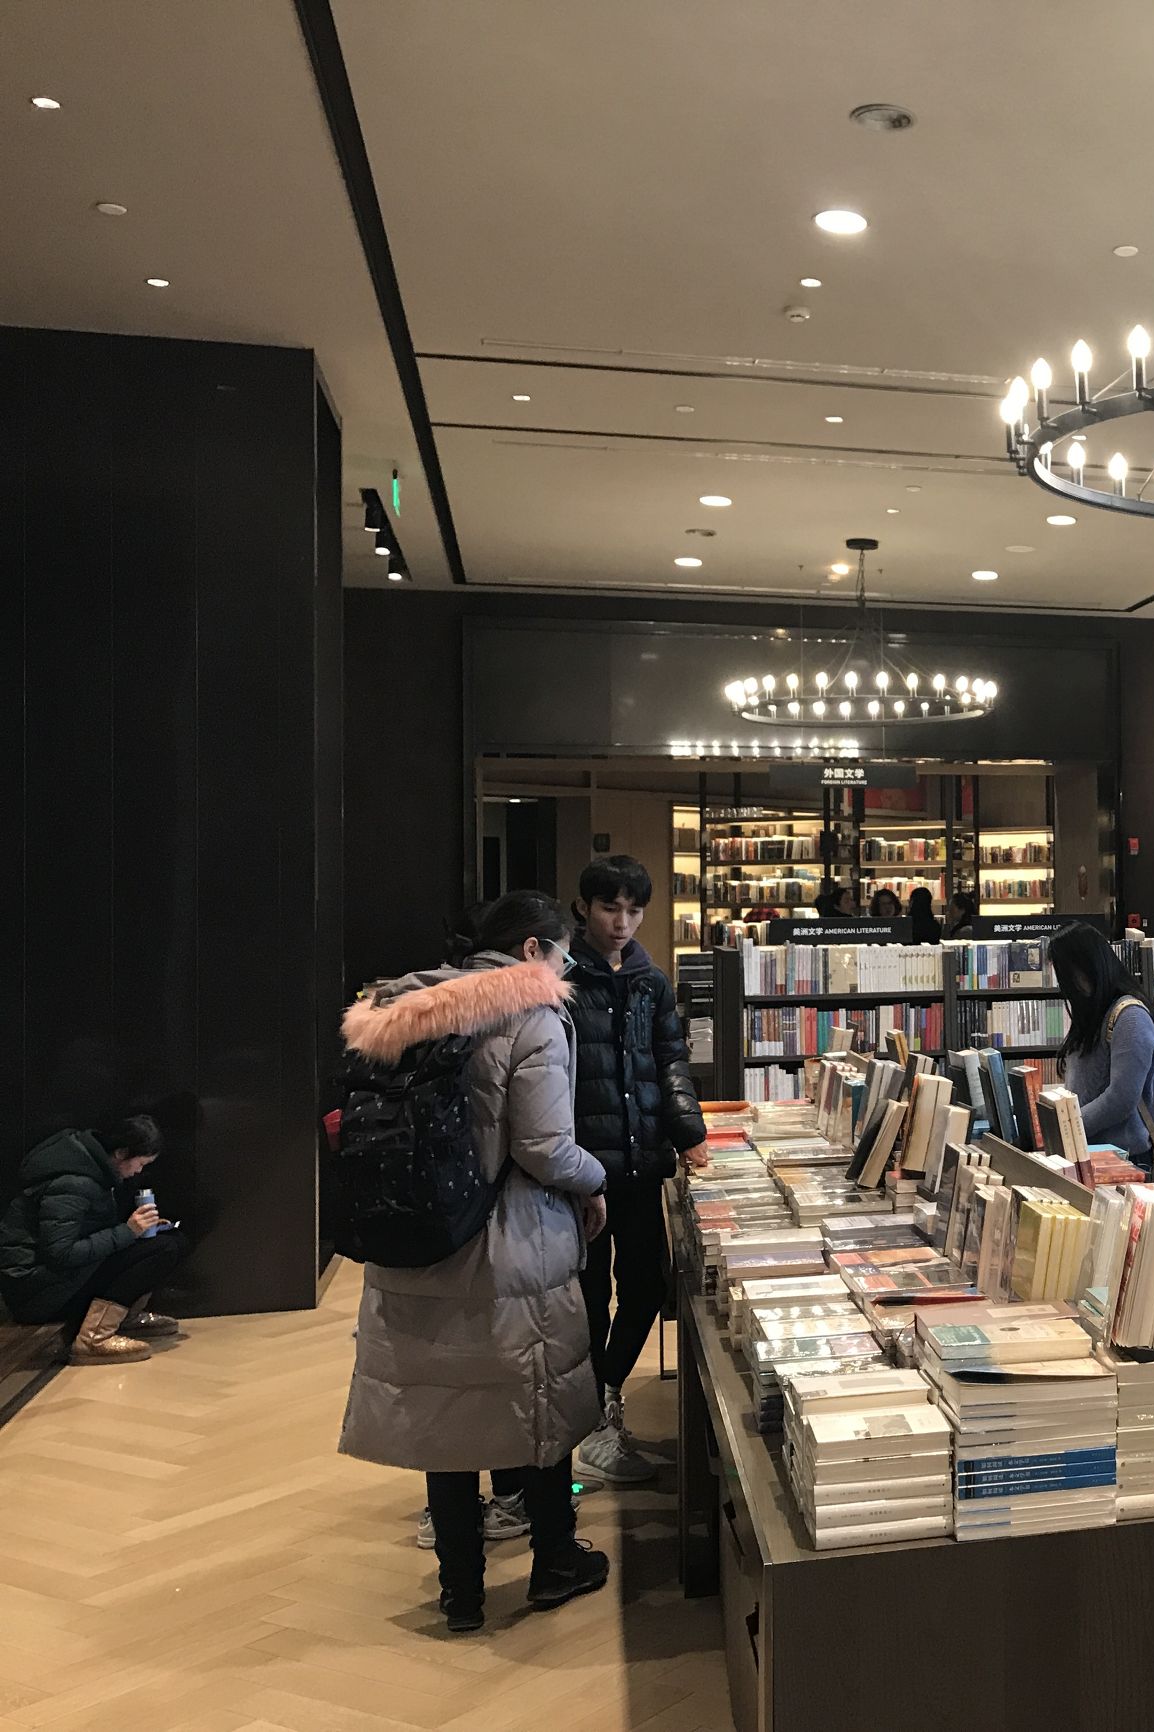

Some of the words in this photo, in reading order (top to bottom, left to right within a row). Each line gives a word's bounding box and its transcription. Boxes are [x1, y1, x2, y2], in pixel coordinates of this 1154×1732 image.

[823, 768, 865, 779] 外国文学
[793, 927, 824, 936] 美洲文学
[856, 926, 892, 934] LITERATURE
[993, 924, 1023, 933] 美洲文学
